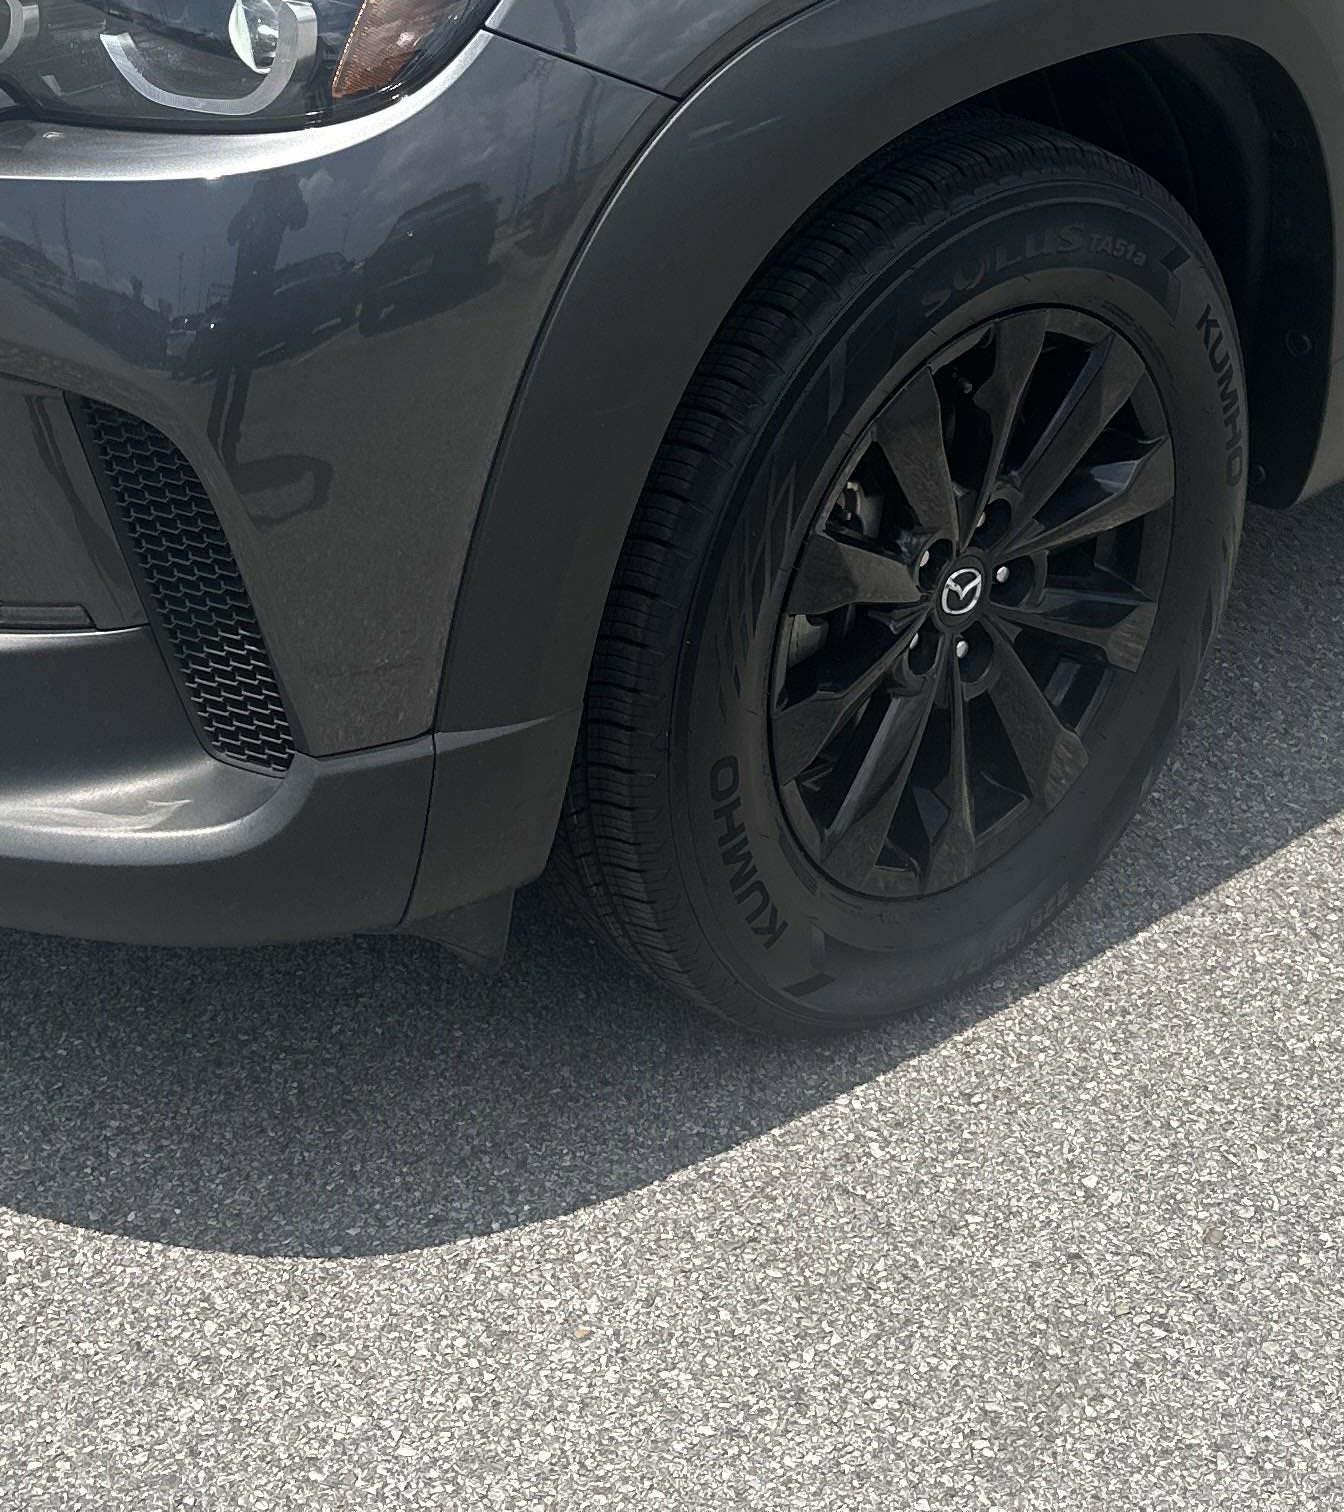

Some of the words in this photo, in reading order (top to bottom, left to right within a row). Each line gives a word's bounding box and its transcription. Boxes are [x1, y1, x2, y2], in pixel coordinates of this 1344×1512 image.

[921, 223, 1086, 317] SOLUS
[1088, 232, 1147, 267] TA51a
[1195, 303, 1243, 487] KUMHO
[709, 755, 789, 950] KUMHO
